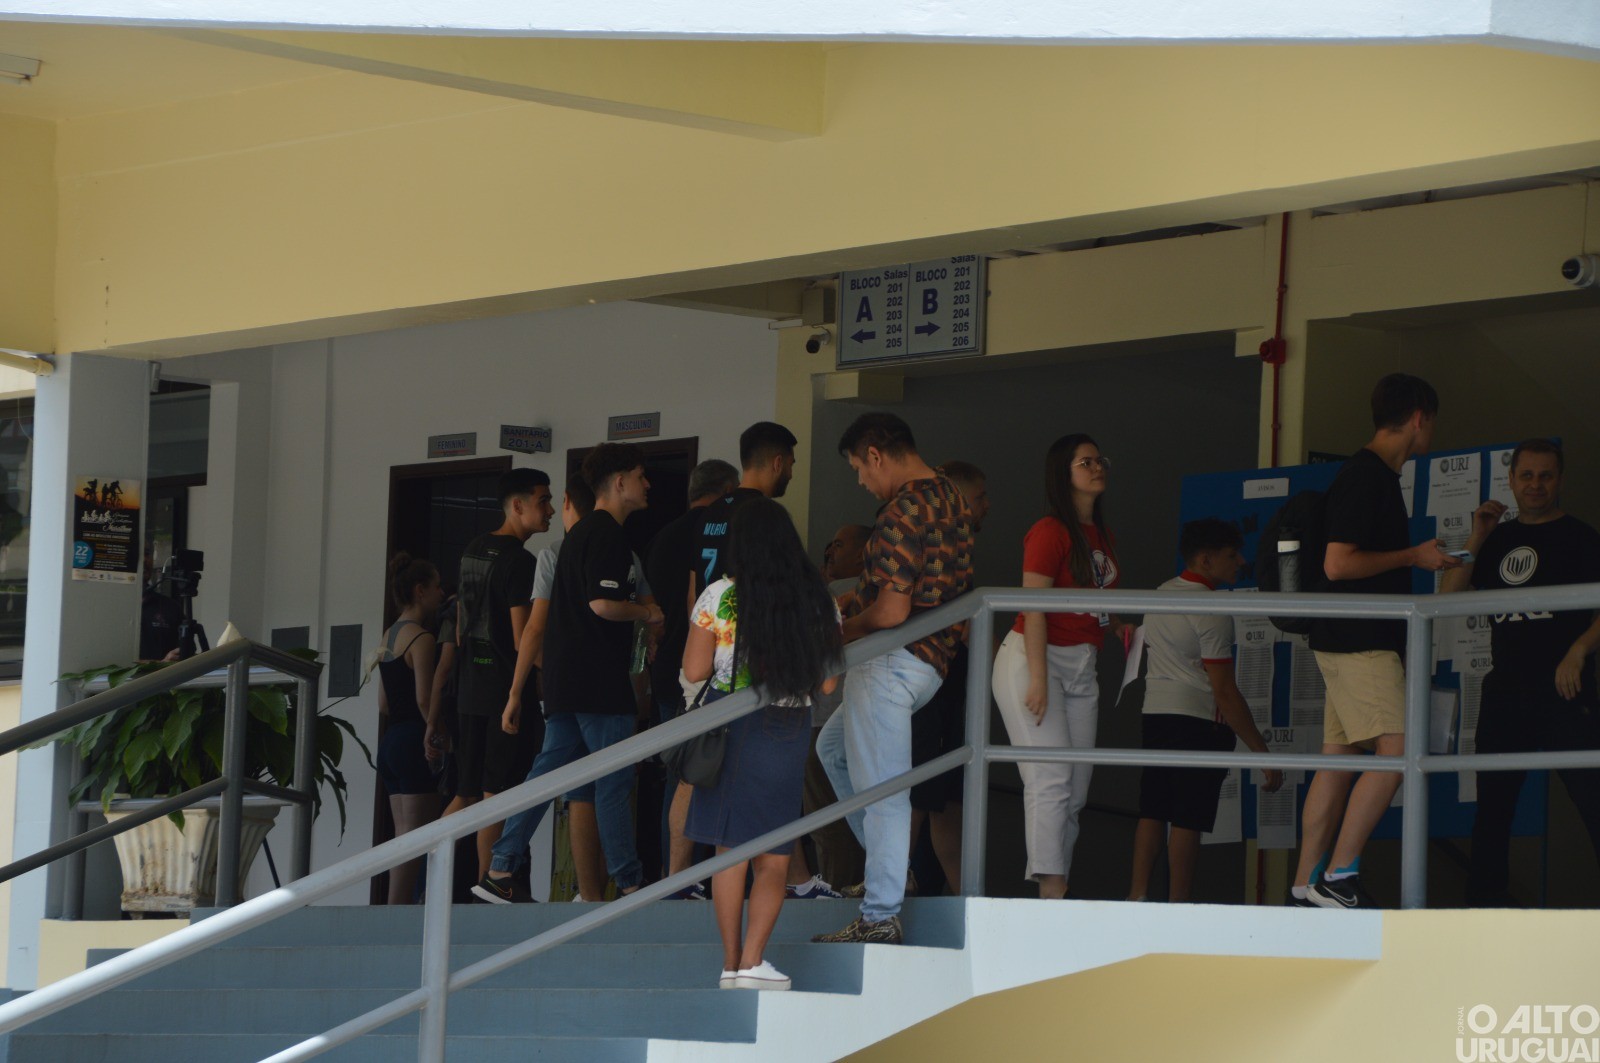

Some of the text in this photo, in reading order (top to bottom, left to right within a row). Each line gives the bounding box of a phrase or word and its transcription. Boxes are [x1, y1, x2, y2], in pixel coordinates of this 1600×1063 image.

[884, 269, 908, 280] Salas
[916, 268, 947, 283] BLOCO
[954, 266, 970, 277] 201
[850, 276, 881, 290] BLOCO
[887, 283, 903, 293] 201
[954, 280, 970, 291] 202
[886, 296, 903, 307] 202
[922, 288, 938, 315] B
[953, 294, 970, 305] 203
[856, 296, 873, 323] A
[953, 309, 969, 319] 204
[886, 310, 902, 321] 203
[886, 324, 902, 335] 204
[952, 322, 969, 333] 205
[886, 338, 902, 349] 205
[952, 336, 969, 347] 206
[616, 419, 652, 431] MASCULINO
[437, 439, 466, 449] FEMININO
[508, 438, 543, 449] 201-A
[1450, 456, 1470, 471] URI
[1451, 517, 1463, 527] URI
[75, 546, 89, 556] 22
[702, 548, 718, 586] 7
[1253, 631, 1265, 640] URI
[1477, 658, 1491, 667] URI
[1274, 729, 1294, 742] URI
